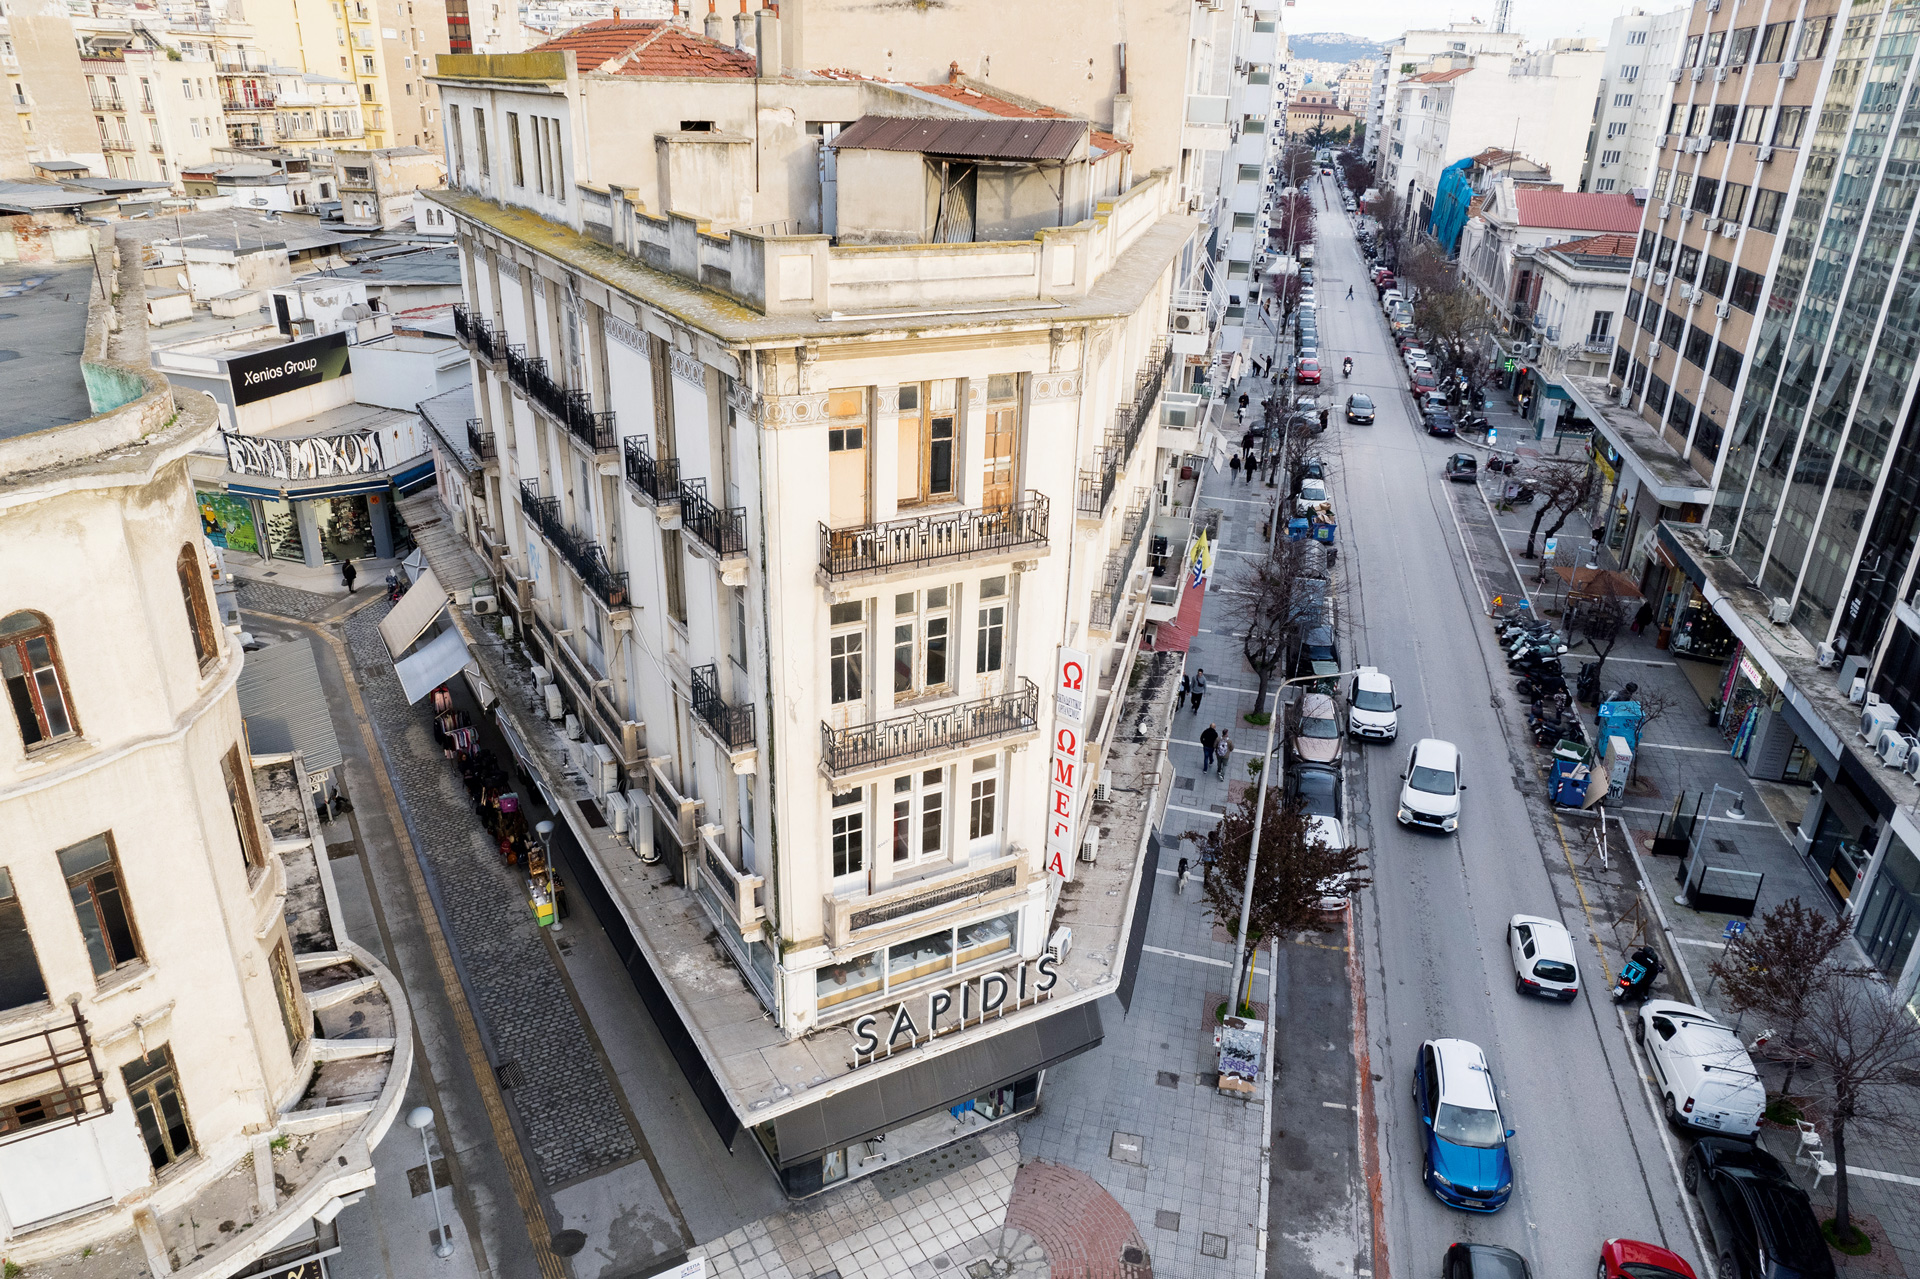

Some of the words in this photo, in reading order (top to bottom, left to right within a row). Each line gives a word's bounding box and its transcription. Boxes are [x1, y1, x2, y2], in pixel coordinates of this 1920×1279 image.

[1272, 63, 1287, 146] HOTEL
[1258, 167, 1275, 263] AMALIA
[244, 366, 283, 386] Xenios
[285, 358, 317, 375] Group
[852, 953, 1058, 1056] SAPIDIS
